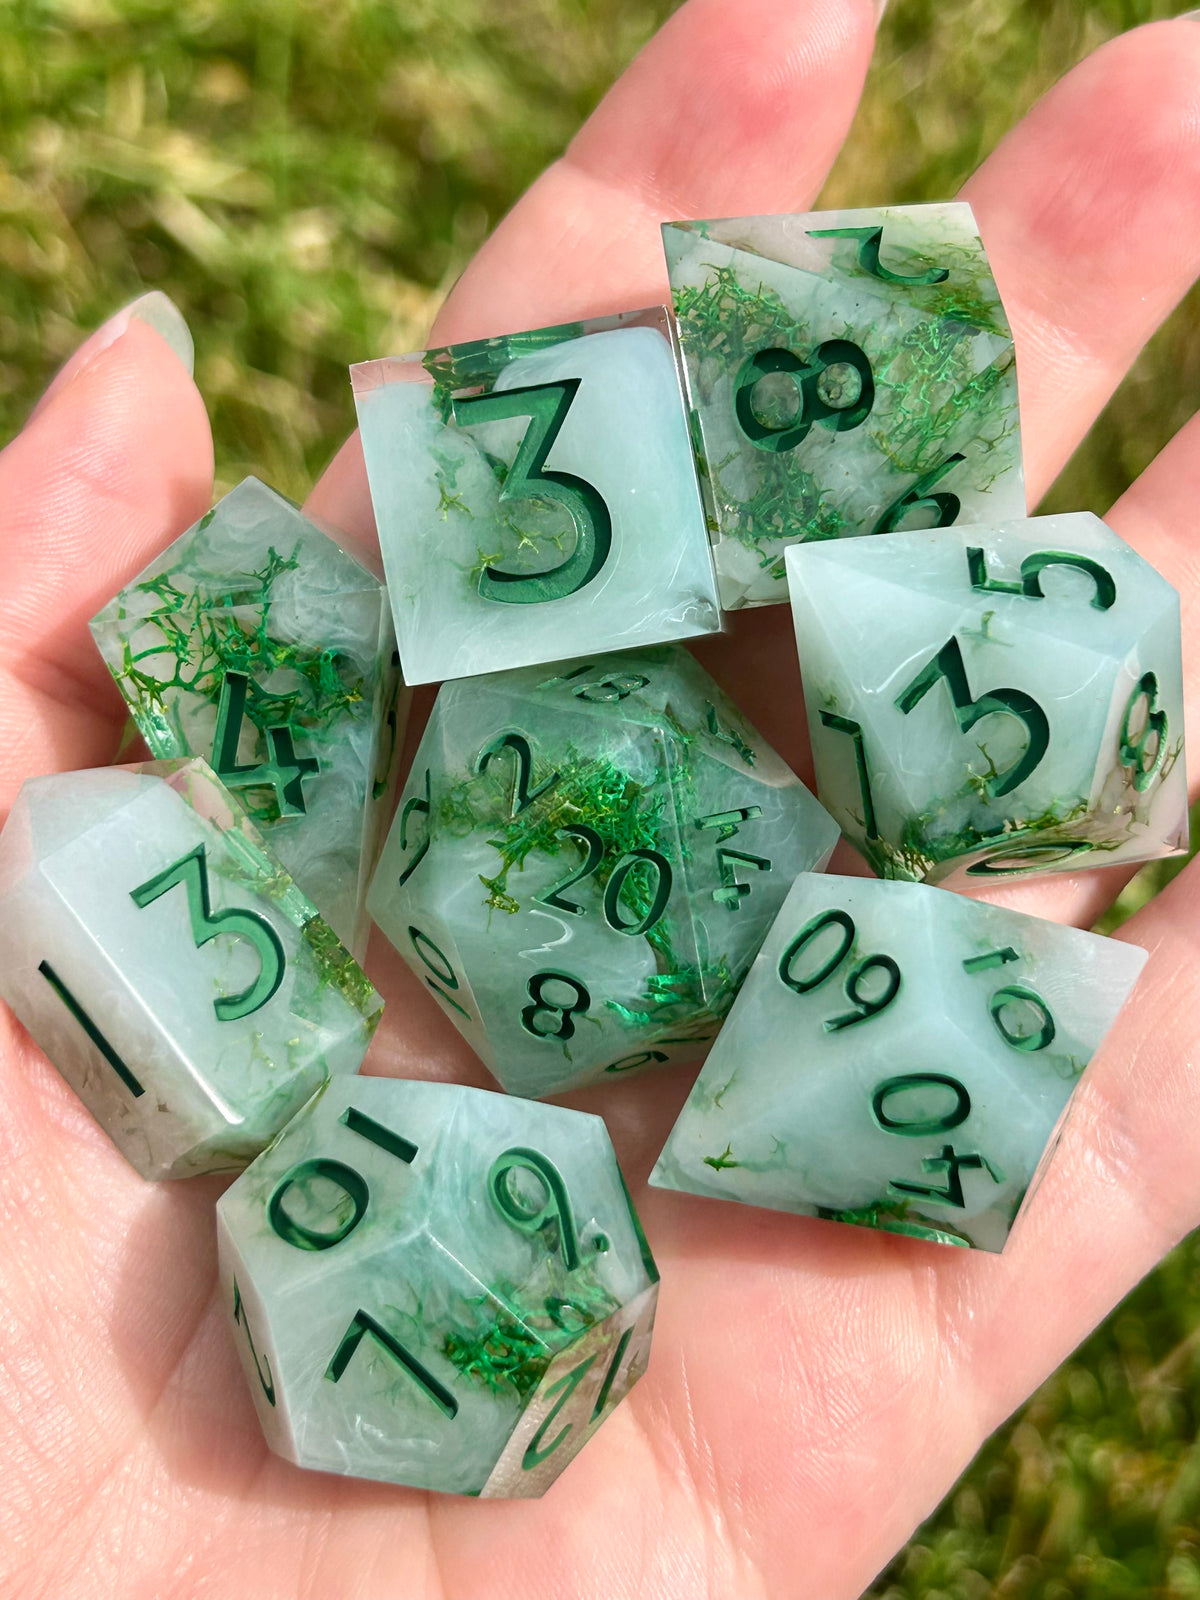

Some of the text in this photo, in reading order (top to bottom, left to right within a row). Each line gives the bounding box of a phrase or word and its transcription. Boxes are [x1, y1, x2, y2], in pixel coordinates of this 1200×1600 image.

[733, 339, 875, 453] 8
[452, 378, 613, 604] 3
[966, 546, 1117, 611] 5
[211, 669, 319, 817] 4
[474, 732, 562, 818] 2
[818, 709, 878, 840] 7
[894, 635, 1050, 798] 3
[1119, 670, 1168, 793] 8
[530, 823, 673, 936] 20
[965, 840, 1094, 877] 0
[129, 842, 286, 1022] 3
[520, 972, 591, 1041] 8
[962, 945, 1056, 1052] 10
[266, 1106, 419, 1251] 10
[872, 1071, 983, 1209] 40
[324, 1308, 460, 1421] 7
[521, 1323, 636, 1471] 12
